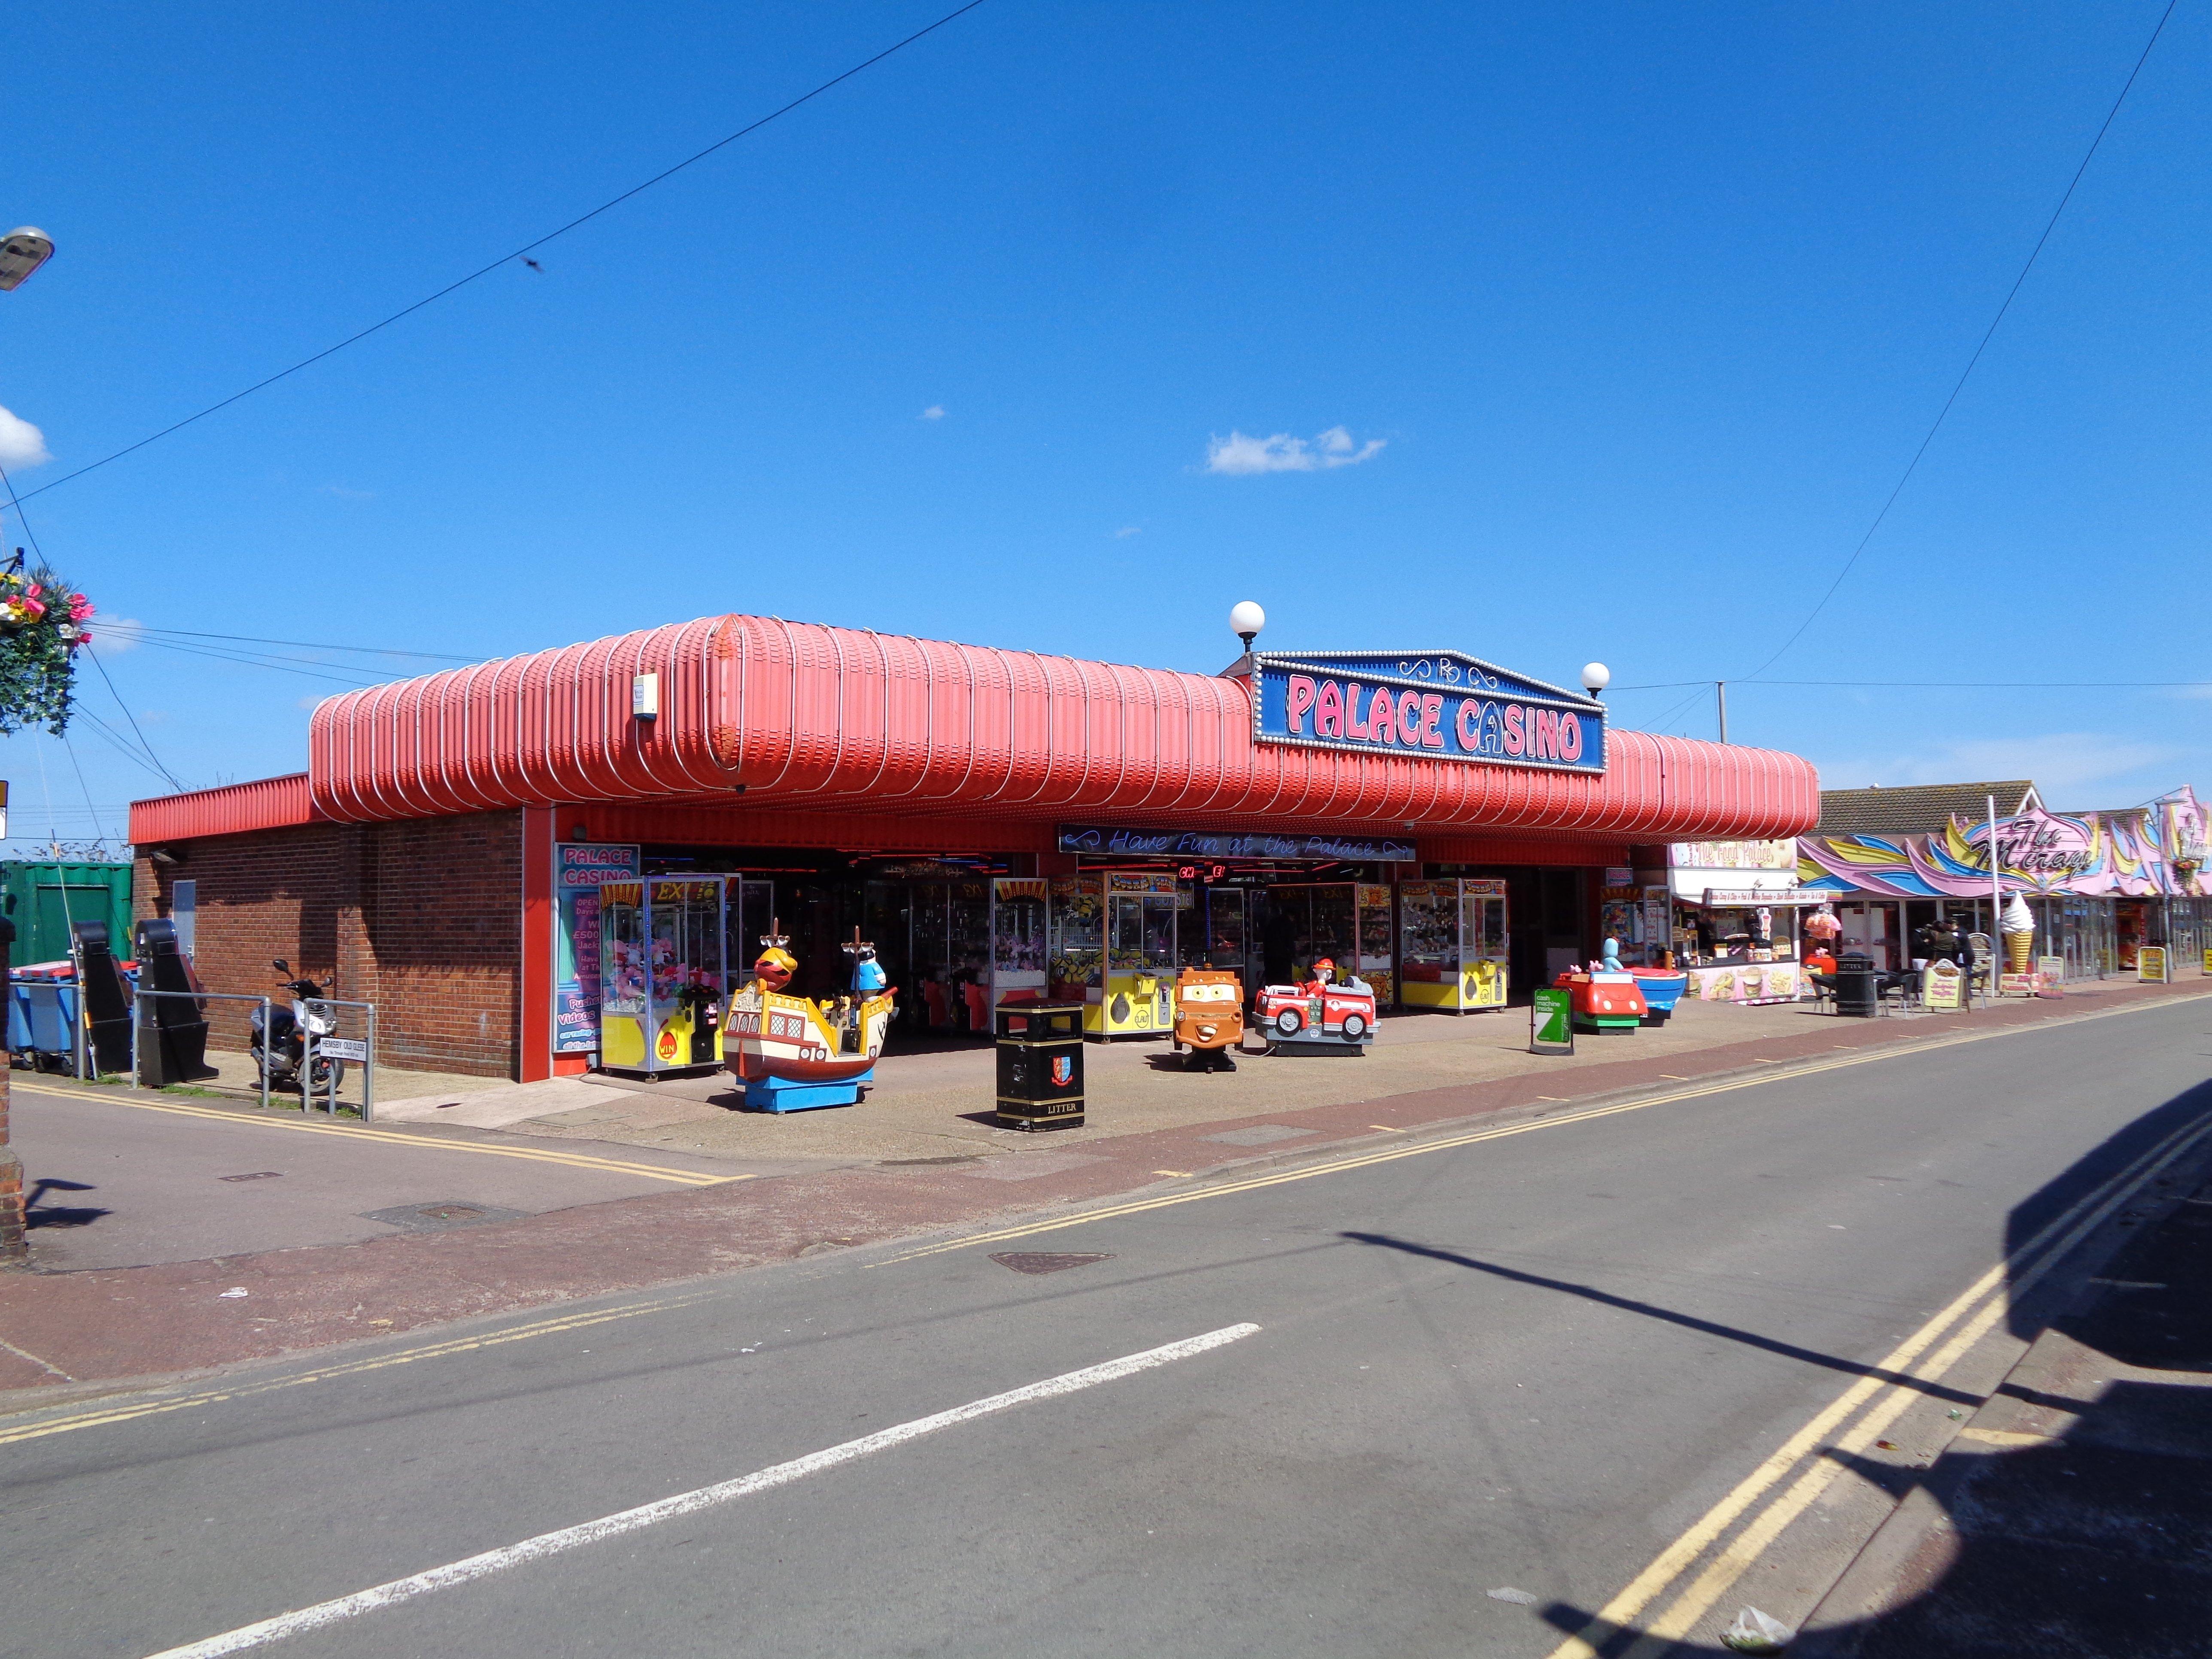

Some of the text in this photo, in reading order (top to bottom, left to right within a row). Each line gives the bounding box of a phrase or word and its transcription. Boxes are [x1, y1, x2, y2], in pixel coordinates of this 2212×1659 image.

[1288, 674, 1582, 762] PALACE CASINO
[1109, 829, 1375, 856] Have Fun at the Palace
[1969, 818, 2092, 878] The Mirage
[564, 848, 632, 865] PALACE
[1698, 842, 1714, 863] The
[1717, 842, 1739, 863] Food
[1743, 841, 1774, 864] Palace
[564, 869, 632, 884] CASINO
[578, 941, 599, 949] Jack
[558, 1010, 596, 1026] Videos
[572, 1029, 591, 1037] racing
[322, 1040, 342, 1049] HEMSBY
[573, 1041, 585, 1049] the
[659, 1044, 674, 1054] WIN
[1048, 1103, 1076, 1115] LITTER
